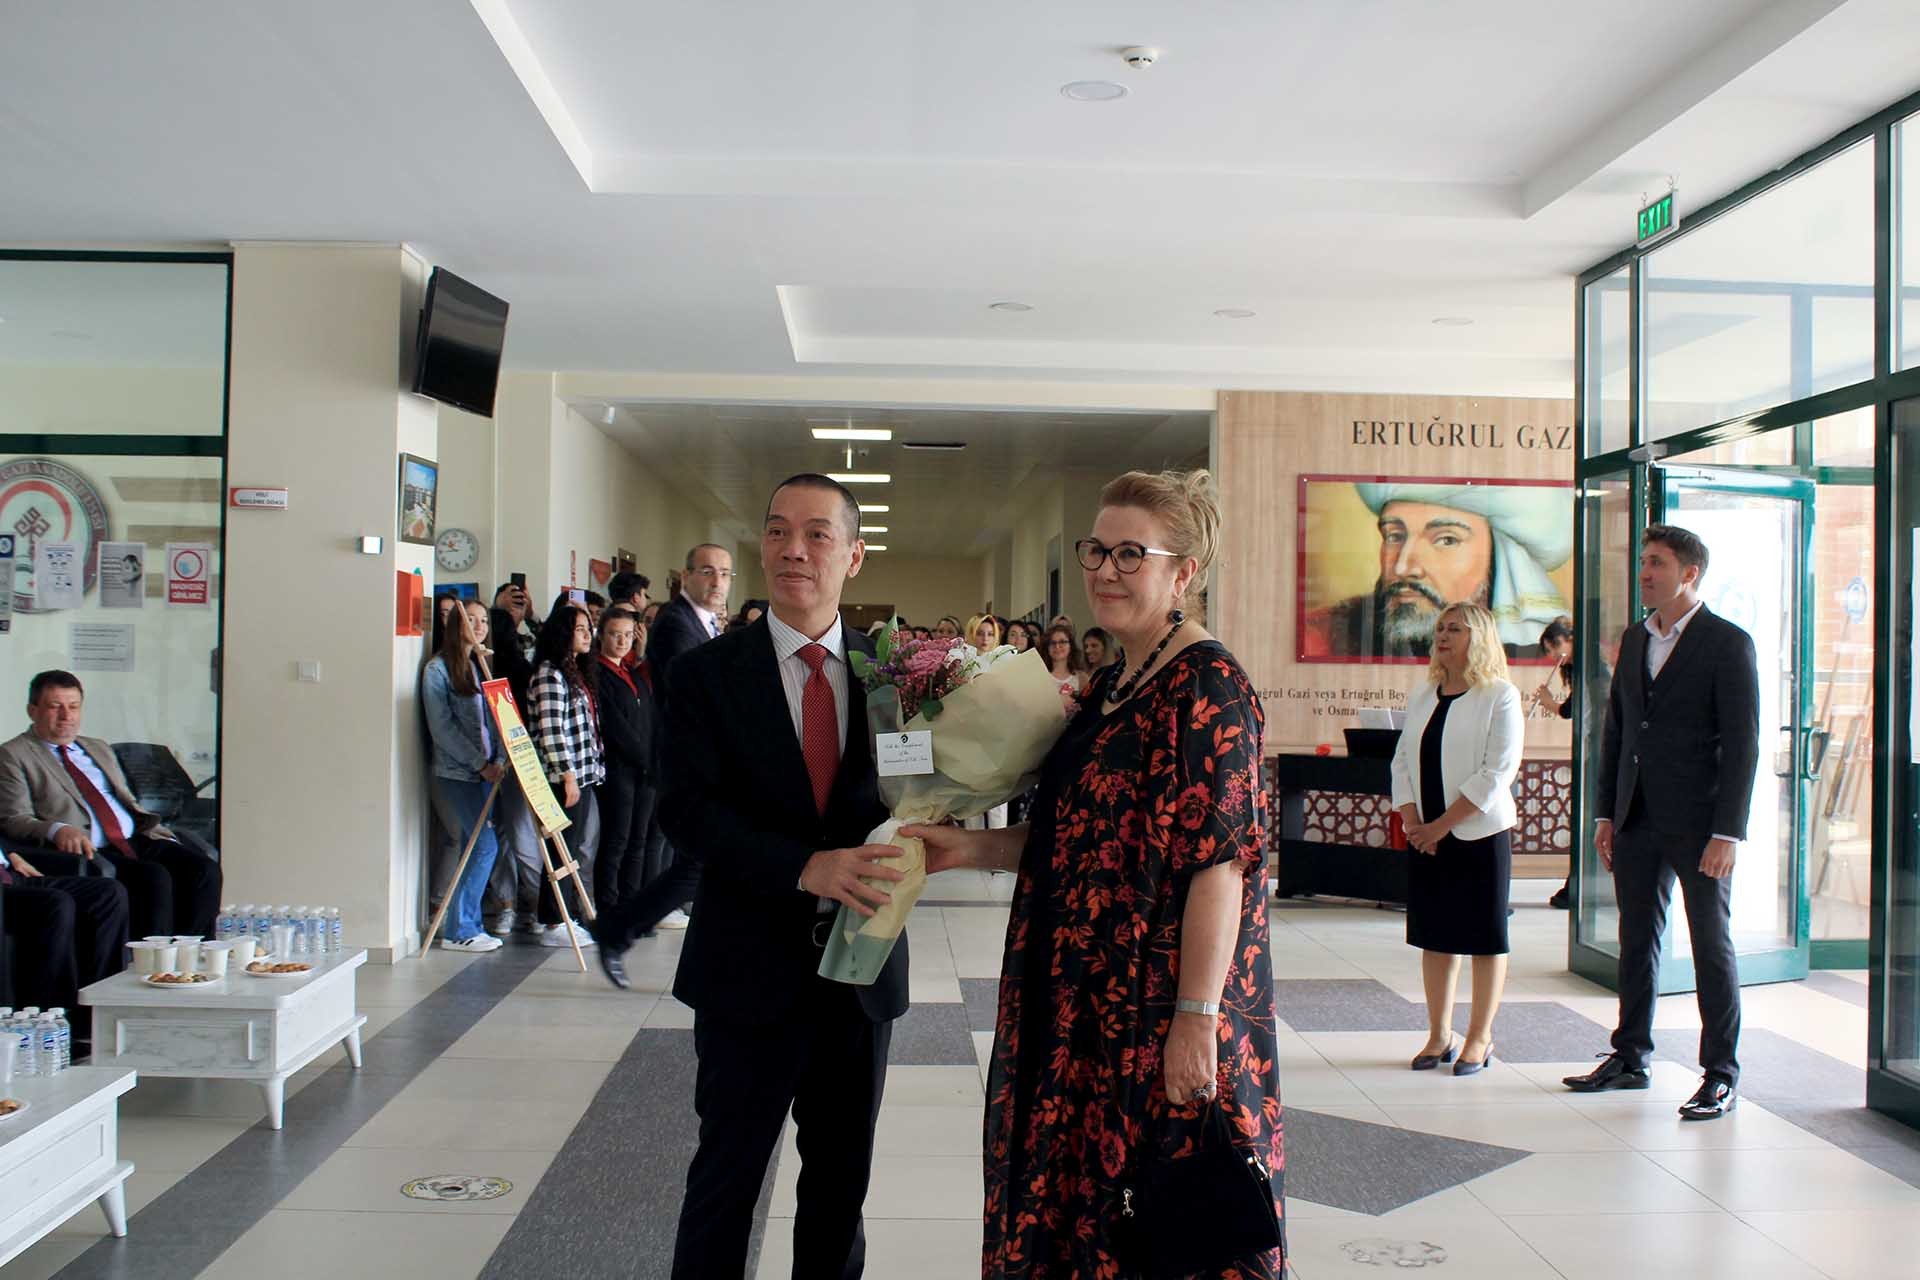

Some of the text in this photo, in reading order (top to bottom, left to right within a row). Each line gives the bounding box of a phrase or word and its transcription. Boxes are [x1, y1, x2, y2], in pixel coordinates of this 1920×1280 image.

[1639, 197, 1671, 241] EXIT
[1352, 416, 1572, 450] ERTUĞRUL GAZ
[1257, 687, 1283, 700] uğrul
[1287, 688, 1311, 699] Gazi
[1314, 691, 1336, 702] veya
[1341, 688, 1384, 701] Ertuğrul
[1388, 689, 1407, 702] Bey
[1312, 707, 1324, 716] ve
[1327, 704, 1361, 716] Osma
